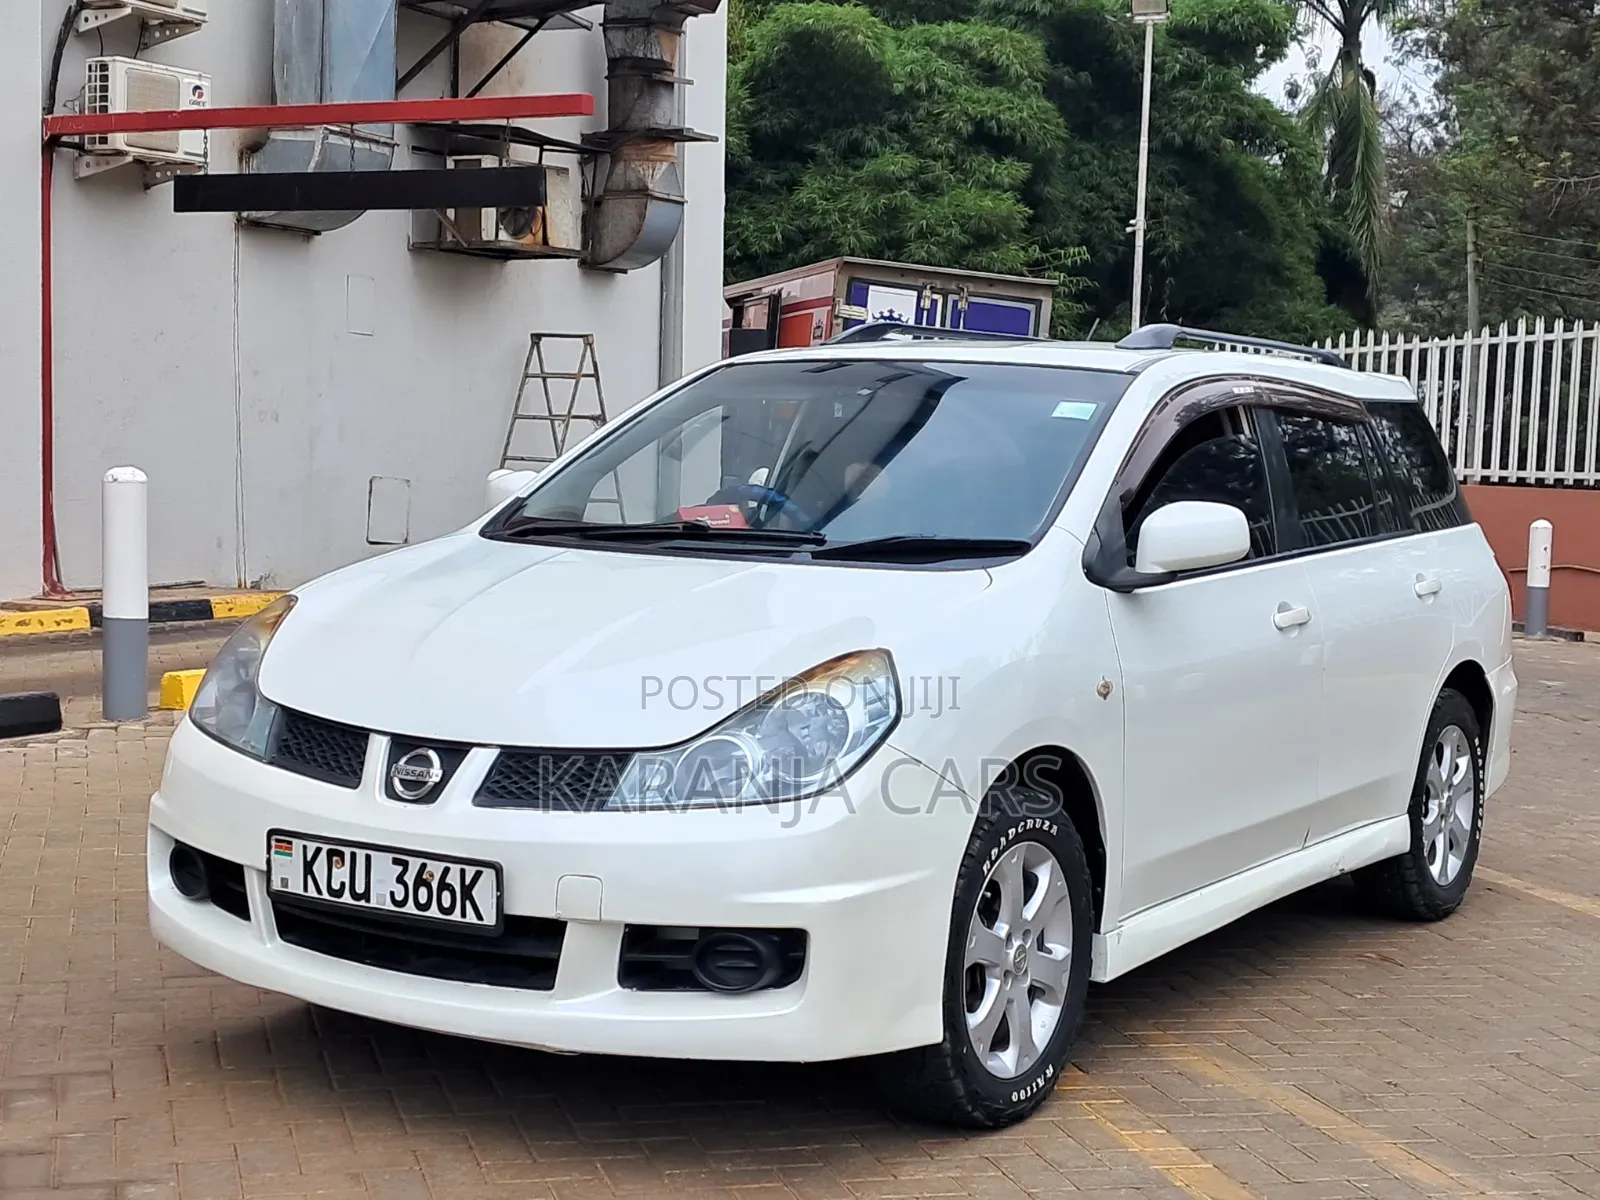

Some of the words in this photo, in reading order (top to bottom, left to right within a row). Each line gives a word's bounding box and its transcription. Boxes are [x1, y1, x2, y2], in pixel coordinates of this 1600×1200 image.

[392, 765, 434, 780] NISSAN
[982, 818, 1059, 876] ROADCRUZA
[302, 843, 372, 904] KCU
[389, 856, 485, 922] 366K
